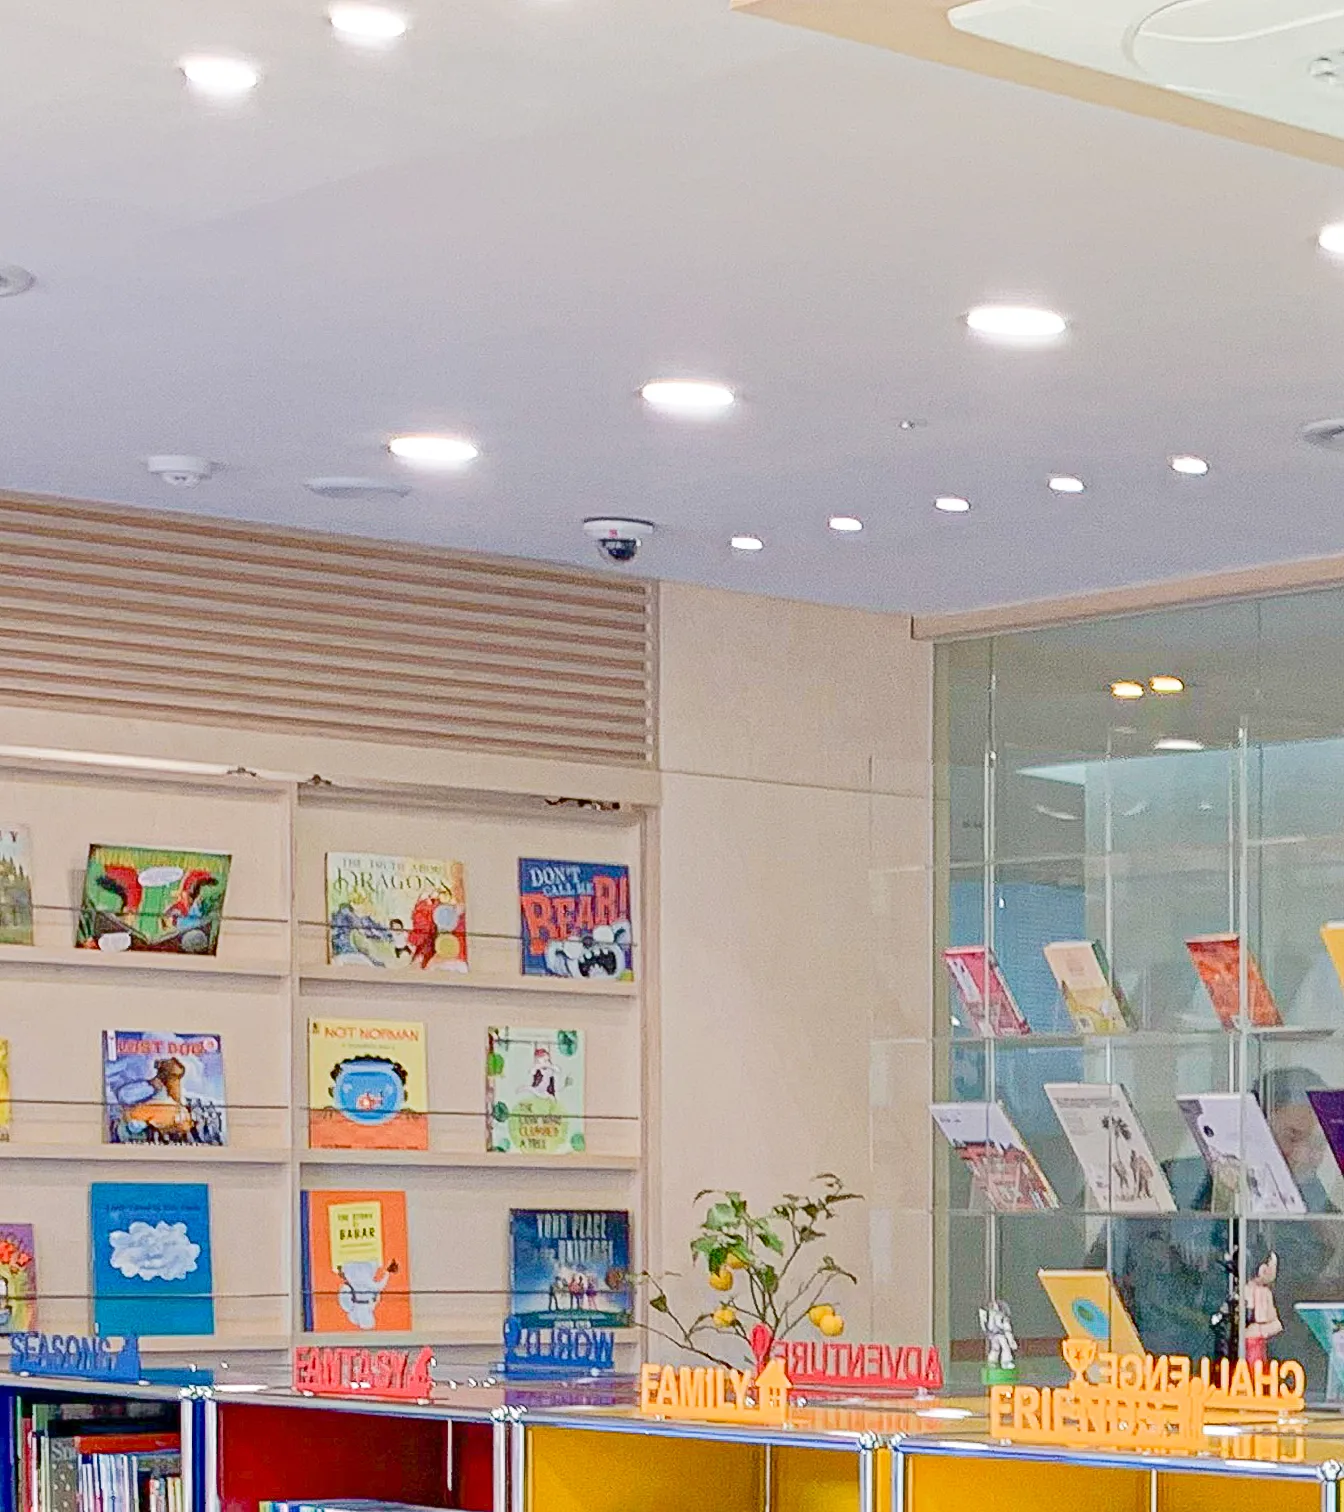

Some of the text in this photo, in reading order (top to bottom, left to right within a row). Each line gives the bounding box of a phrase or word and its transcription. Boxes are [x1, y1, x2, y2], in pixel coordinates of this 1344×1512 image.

[333, 866, 453, 895] DRAGONS
[529, 864, 581, 887] DON'T
[116, 1038, 163, 1055] LOST
[323, 1026, 420, 1042] NOT NORMAN
[339, 1227, 376, 1241] BABAR
[10, 1331, 120, 1373] SEASONS
[295, 1345, 409, 1389] FANTASY
[641, 1363, 752, 1412] FAMILY
